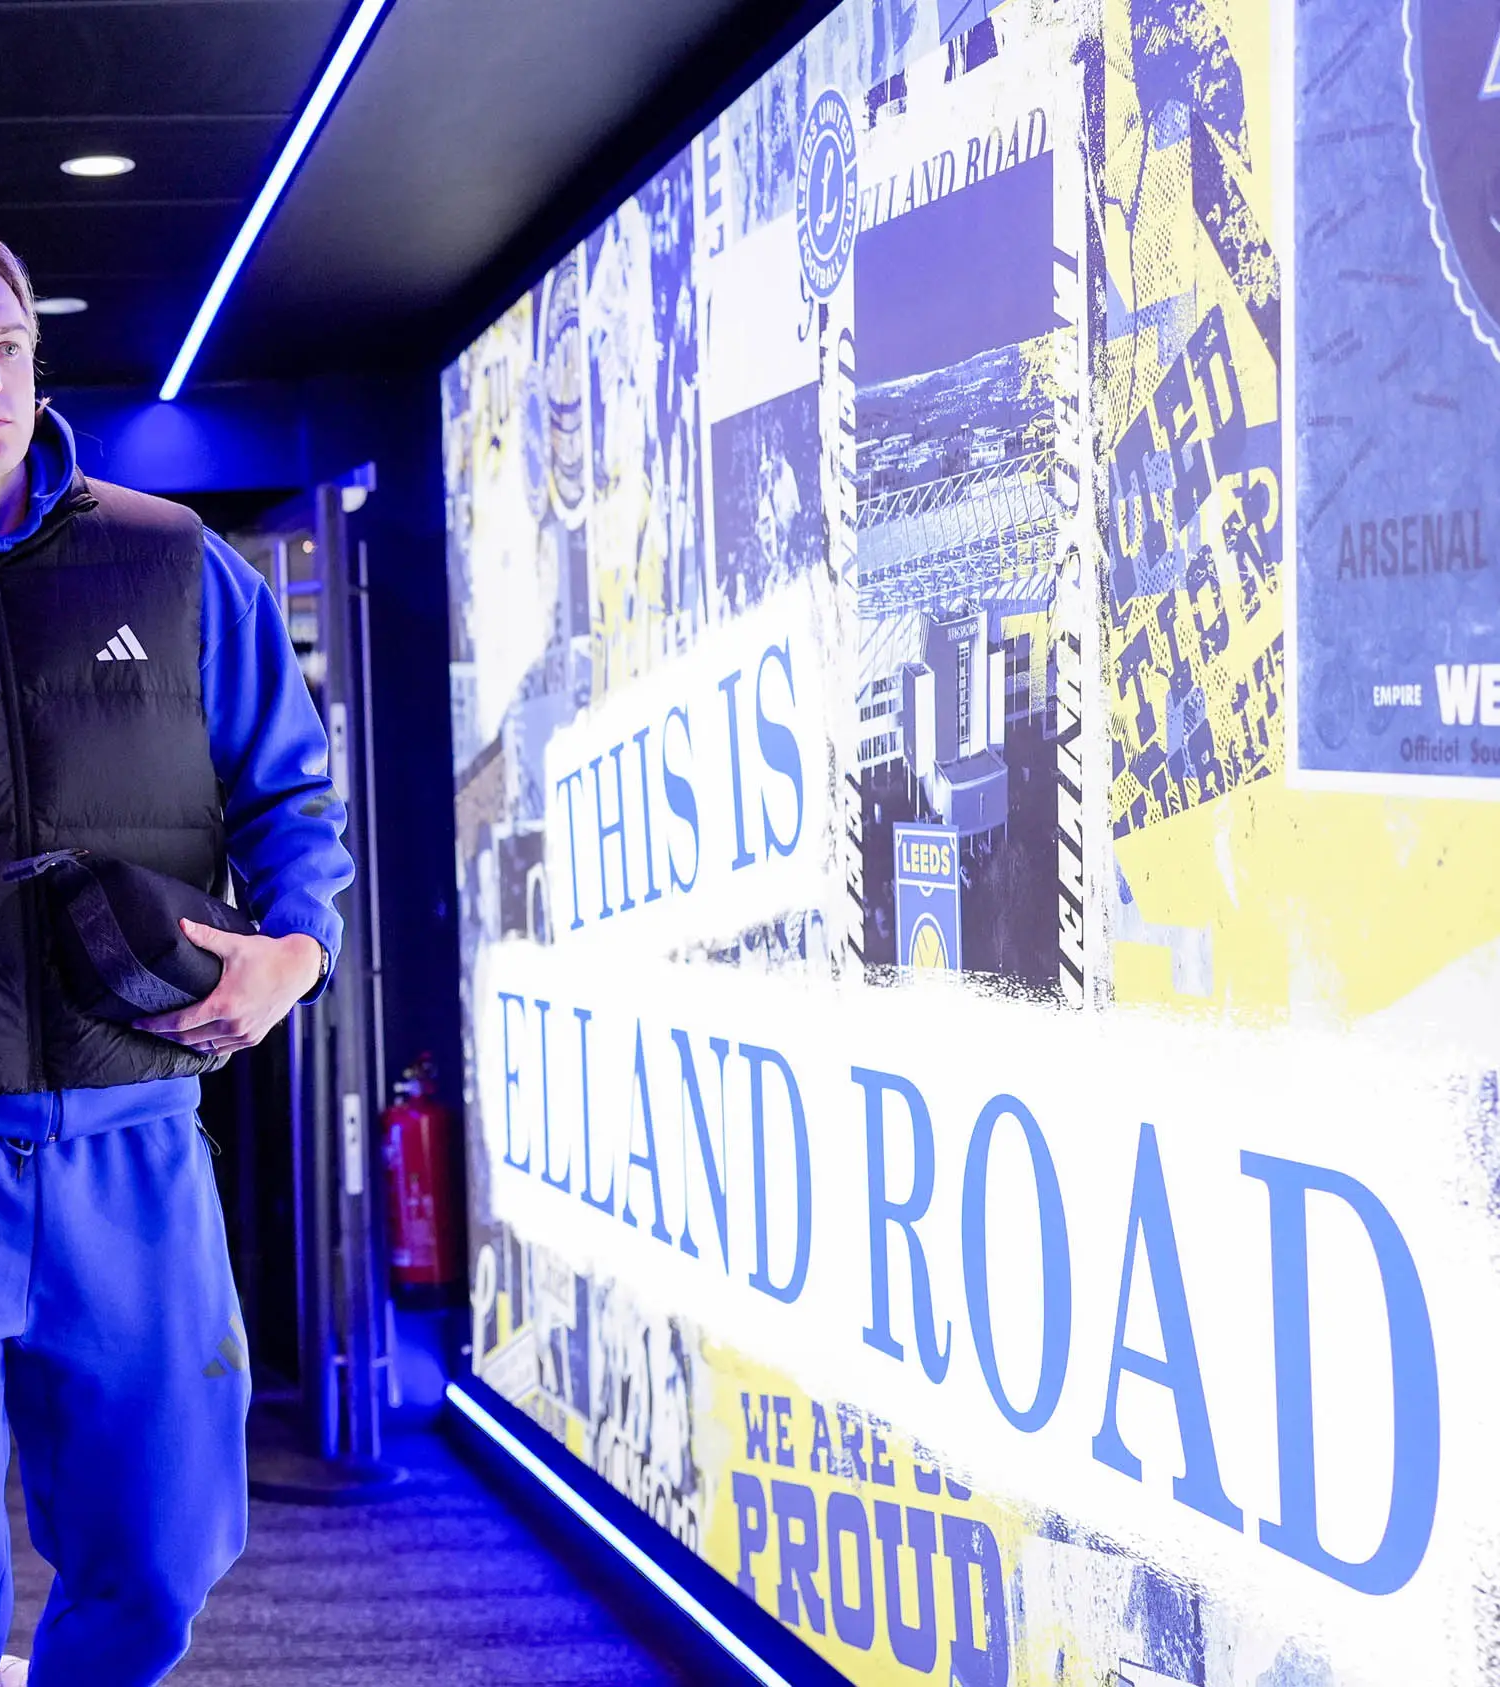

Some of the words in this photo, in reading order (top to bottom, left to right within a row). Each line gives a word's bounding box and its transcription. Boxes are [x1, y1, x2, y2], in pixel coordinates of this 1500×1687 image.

[818, 99, 853, 156] UNITED
[858, 150, 956, 233] ELLAND
[964, 107, 1047, 188] ROAD
[800, 231, 843, 290] FOOTBALL
[1337, 508, 1488, 581] ARSENAL
[1373, 684, 1422, 707] EMPIRE
[556, 703, 700, 930] THIS
[718, 635, 804, 872] IS
[1400, 736, 1460, 763] Official
[901, 841, 952, 876] LEEDS
[498, 991, 812, 1305] ELLAND
[851, 1065, 1441, 1596] ROAD
[740, 1391, 796, 1468] WE
[810, 1400, 896, 1488] ARE
[731, 1470, 1010, 1687] PROUD
